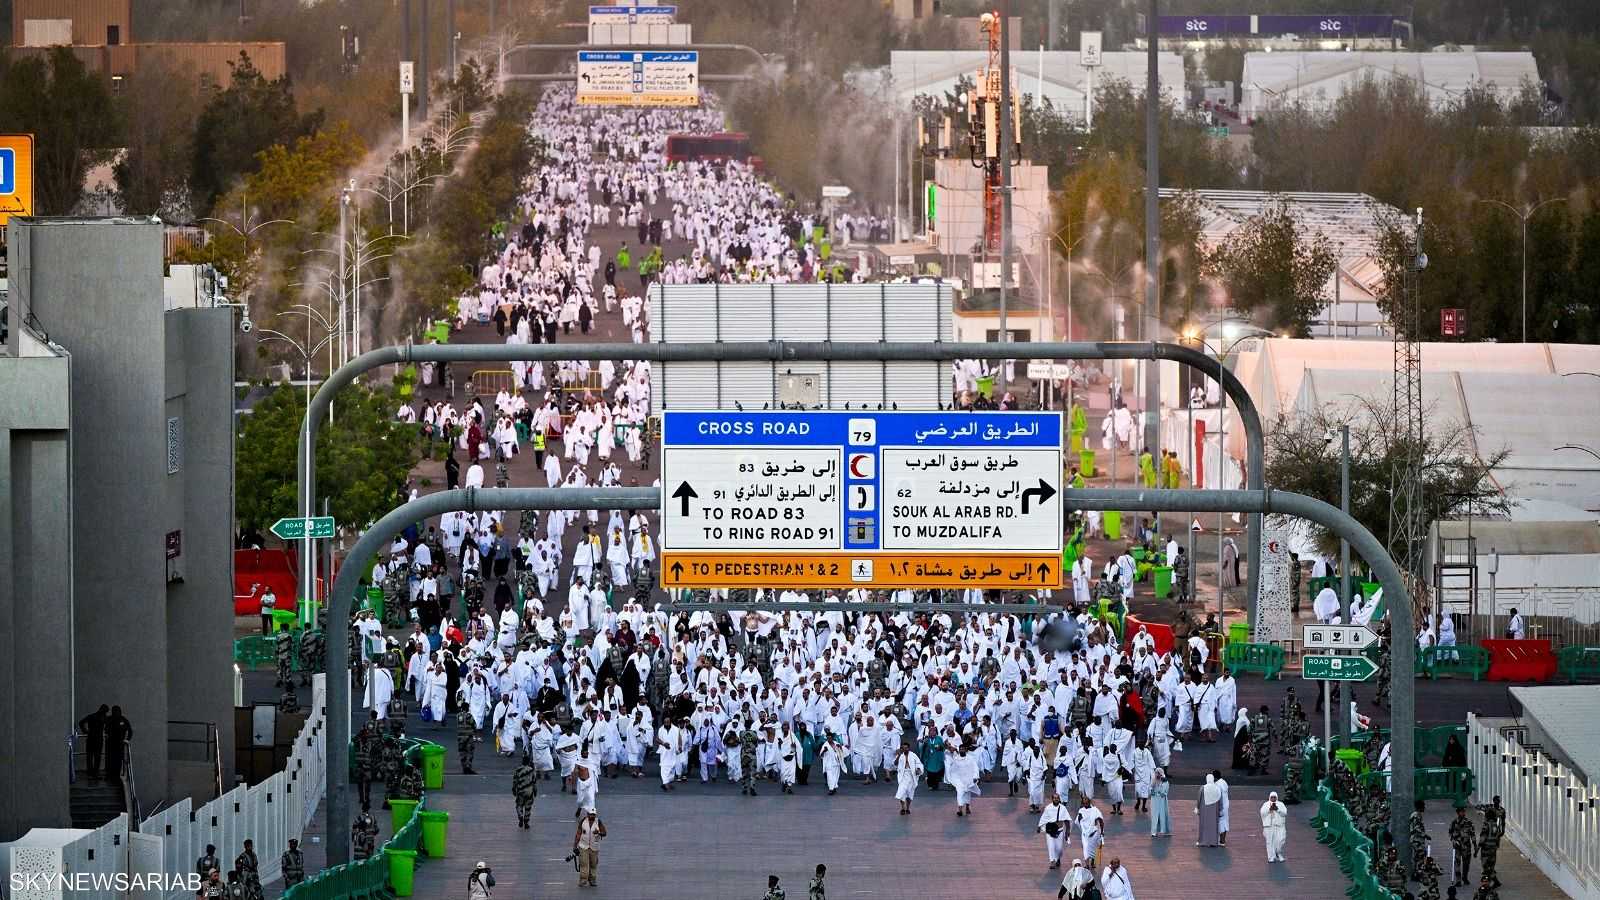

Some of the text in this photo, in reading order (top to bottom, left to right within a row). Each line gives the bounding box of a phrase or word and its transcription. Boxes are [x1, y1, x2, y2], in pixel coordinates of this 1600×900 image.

[1186, 19, 1207, 31] stc
[1320, 19, 1341, 31] stc
[698, 421, 810, 435] CROSS ROAD
[915, 421, 1039, 443] الطريق العرضي
[853, 431, 872, 443] 79
[739, 463, 755, 472] 83
[812, 459, 836, 477] إلى
[905, 453, 1018, 471] طريق سوق العرب
[713, 483, 836, 502] إلى الطريق الدائري 91
[897, 480, 1020, 499] إلى مزدلفة 62
[702, 507, 805, 520] TO ROAD 83
[892, 506, 1017, 518] SOUK AL ARAB RD.
[703, 527, 834, 540] TO RING ROAD 91
[892, 525, 1002, 538] TO MUZDALIFA
[692, 563, 710, 576] TO
[715, 563, 804, 576] PEDESTRIAN
[817, 563, 827, 576] &
[829, 563, 840, 576] 2
[915, 562, 953, 576] مشاة
[959, 562, 1002, 577] طريق
[1008, 562, 1033, 578] إلى
[1343, 660, 1361, 668] طريق
